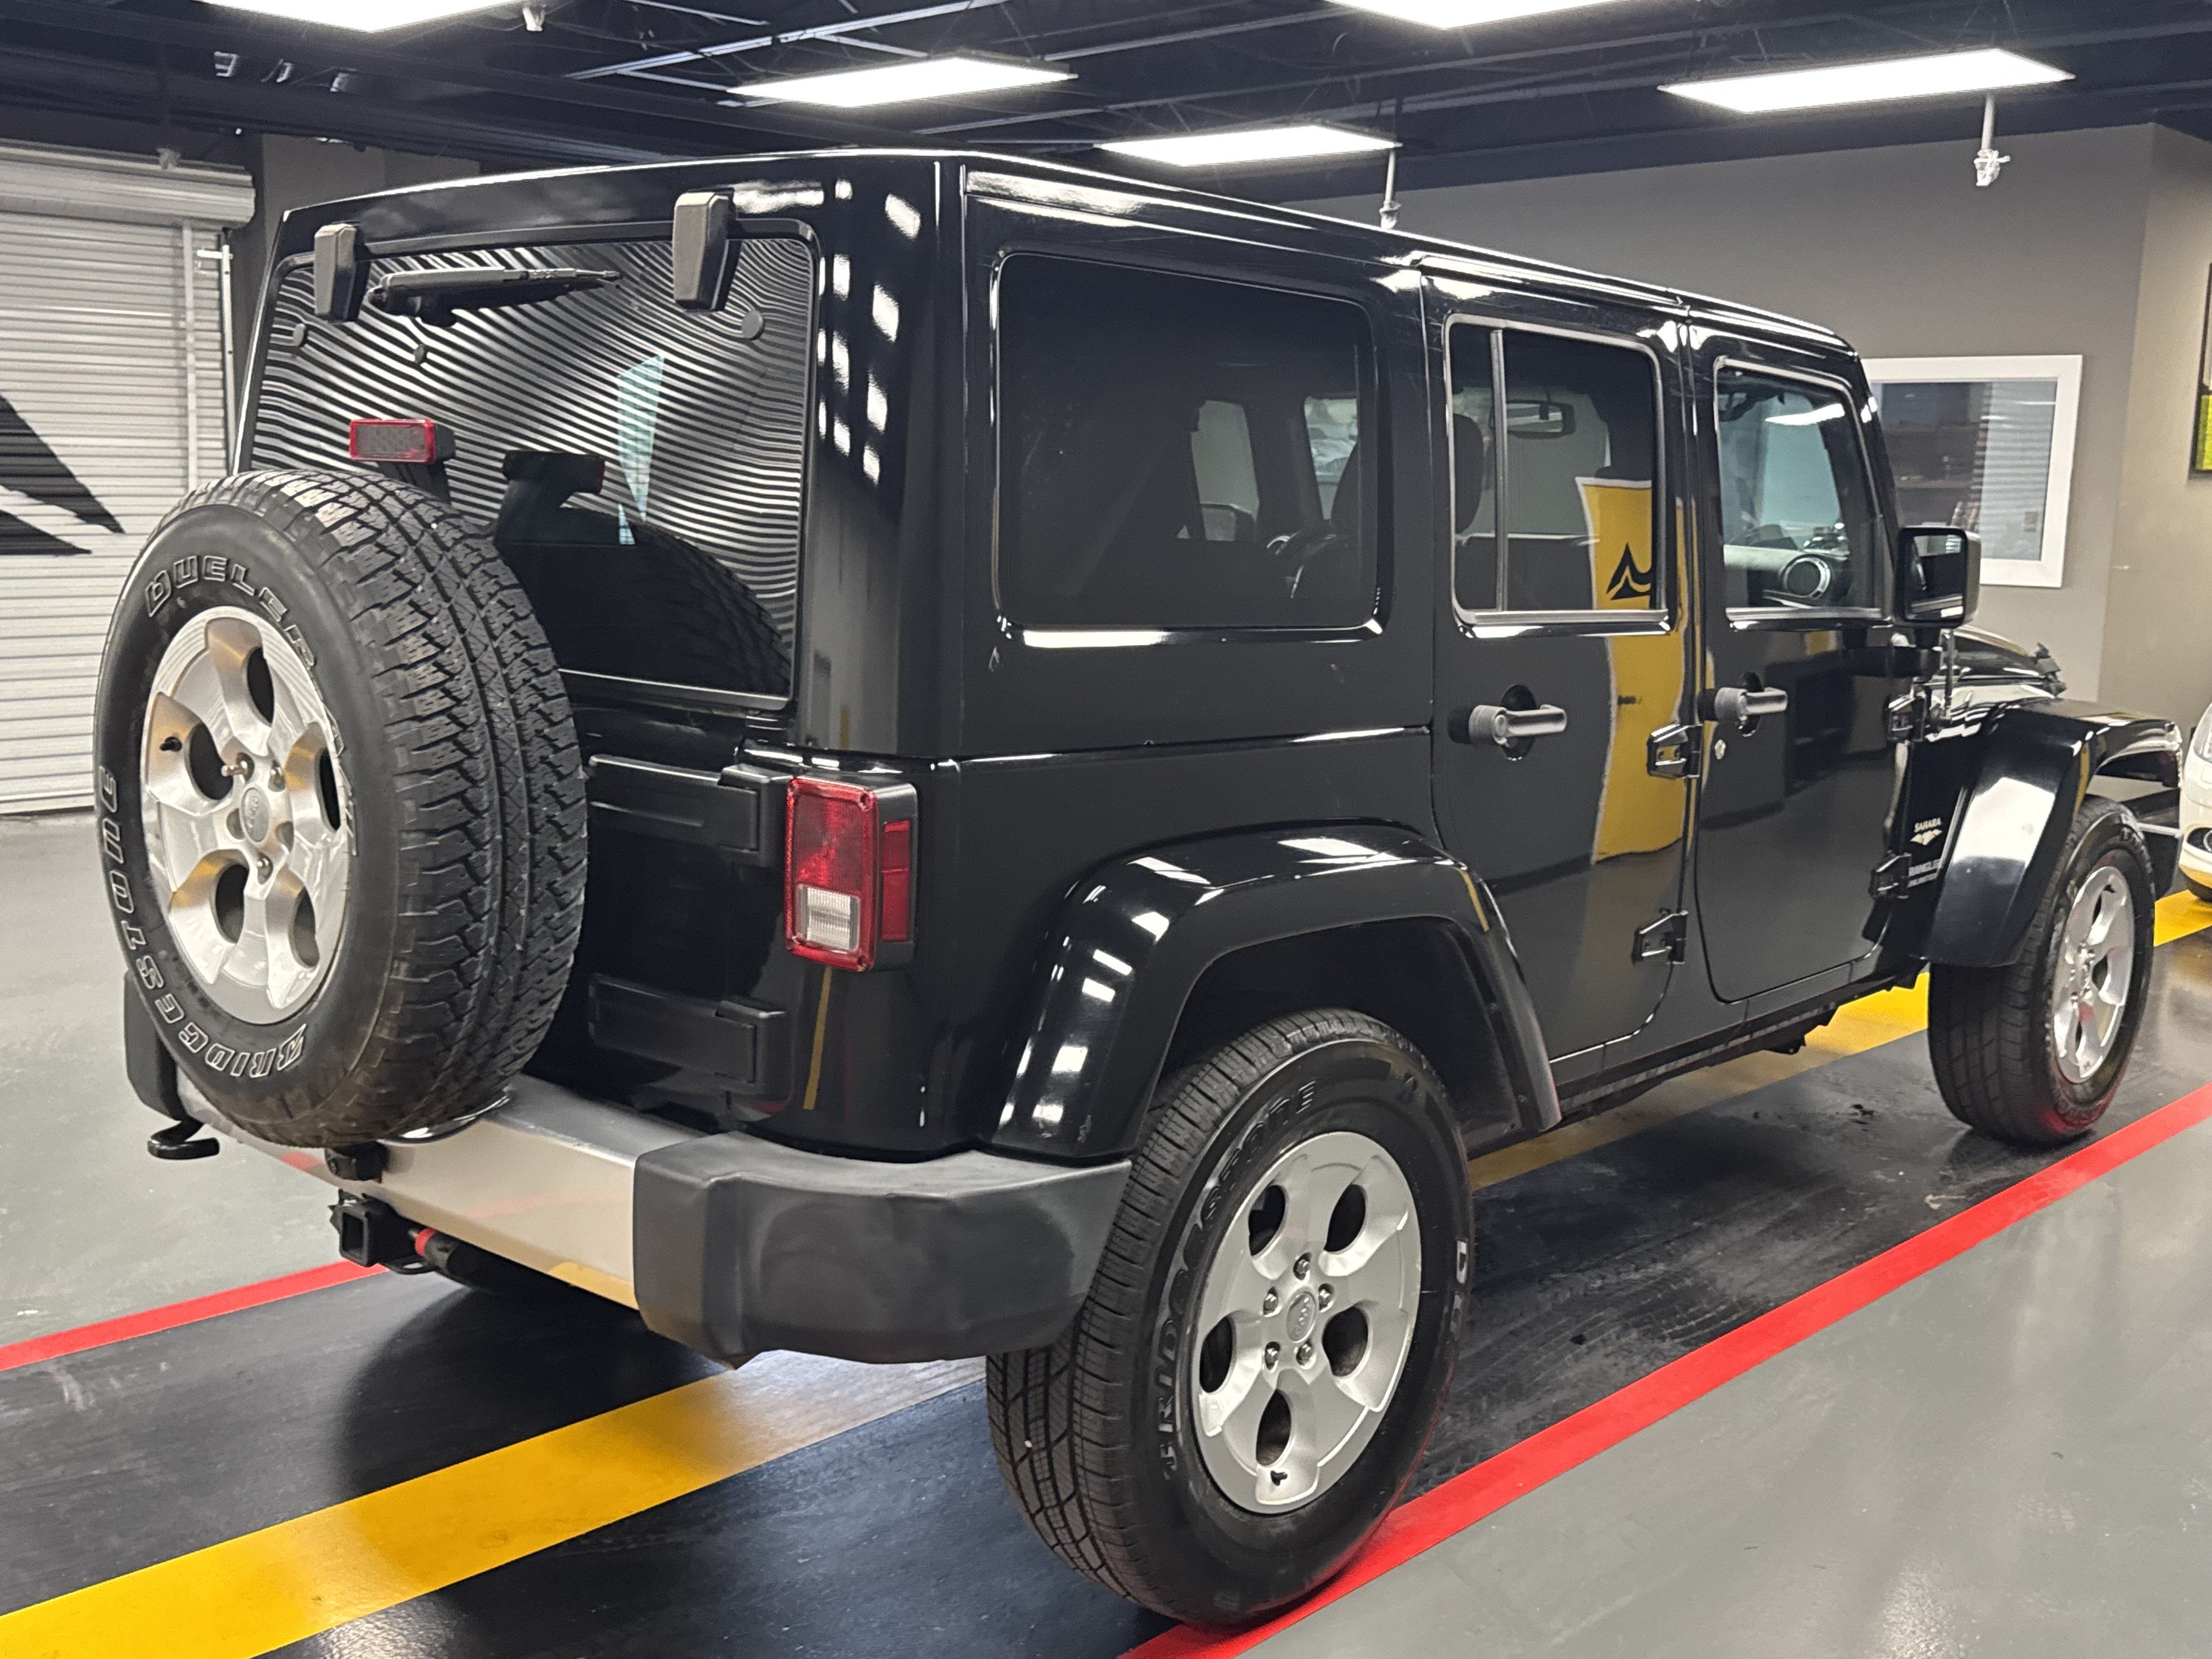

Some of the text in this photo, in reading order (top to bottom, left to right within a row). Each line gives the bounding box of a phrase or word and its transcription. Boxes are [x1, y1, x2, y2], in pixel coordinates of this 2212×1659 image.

[144, 555, 315, 667] DUELER
[1914, 817, 1942, 833] SAHARA
[99, 765, 307, 1079] BRIDGESTONE
